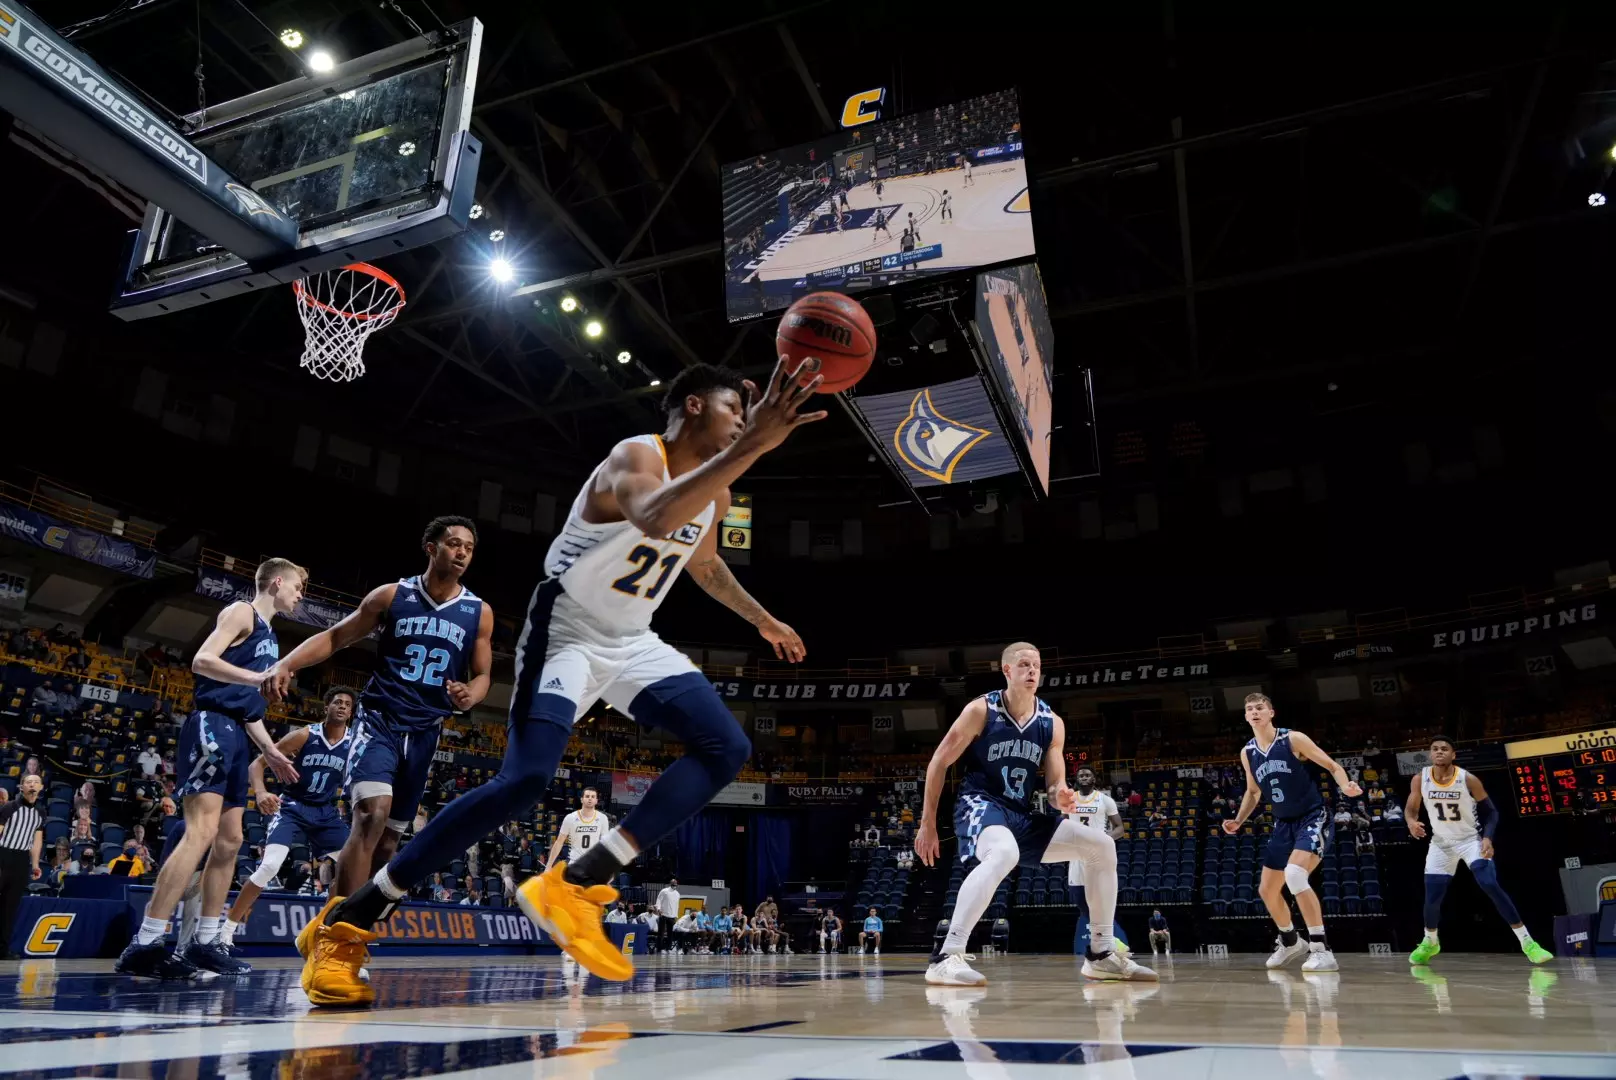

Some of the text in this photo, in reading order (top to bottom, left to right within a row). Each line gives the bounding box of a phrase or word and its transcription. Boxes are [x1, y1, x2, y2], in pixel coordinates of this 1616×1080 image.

[883, 255, 898, 266] 42
[823, 267, 842, 276] CITADEL
[846, 264, 861, 275] 45
[611, 543, 684, 600] 21
[1432, 603, 1598, 649] EQUIPPING
[394, 616, 467, 651] CITADEL
[399, 643, 451, 688] 32
[88, 686, 111, 701] 115
[752, 683, 817, 699] CLUB
[828, 682, 912, 699] TODAY
[1192, 697, 1213, 710] 222
[875, 717, 891, 729] 220
[435, 751, 449, 761] 116
[1340, 757, 1359, 766] 122
[1182, 769, 1198, 778] 121
[1553, 768, 1574, 777] MOCS
[1596, 774, 1605, 784] 2
[307, 770, 330, 794] 11
[898, 782, 914, 790] 120
[1001, 764, 1028, 800] 13
[1558, 776, 1577, 789] 42
[788, 786, 854, 797] RUBY FALLS
[1269, 778, 1285, 803] 5
[1428, 791, 1461, 800] MOCS
[1434, 802, 1462, 821] 13
[581, 835, 590, 848] 0
[1209, 945, 1227, 958] 121
[1372, 944, 1390, 955] 122
